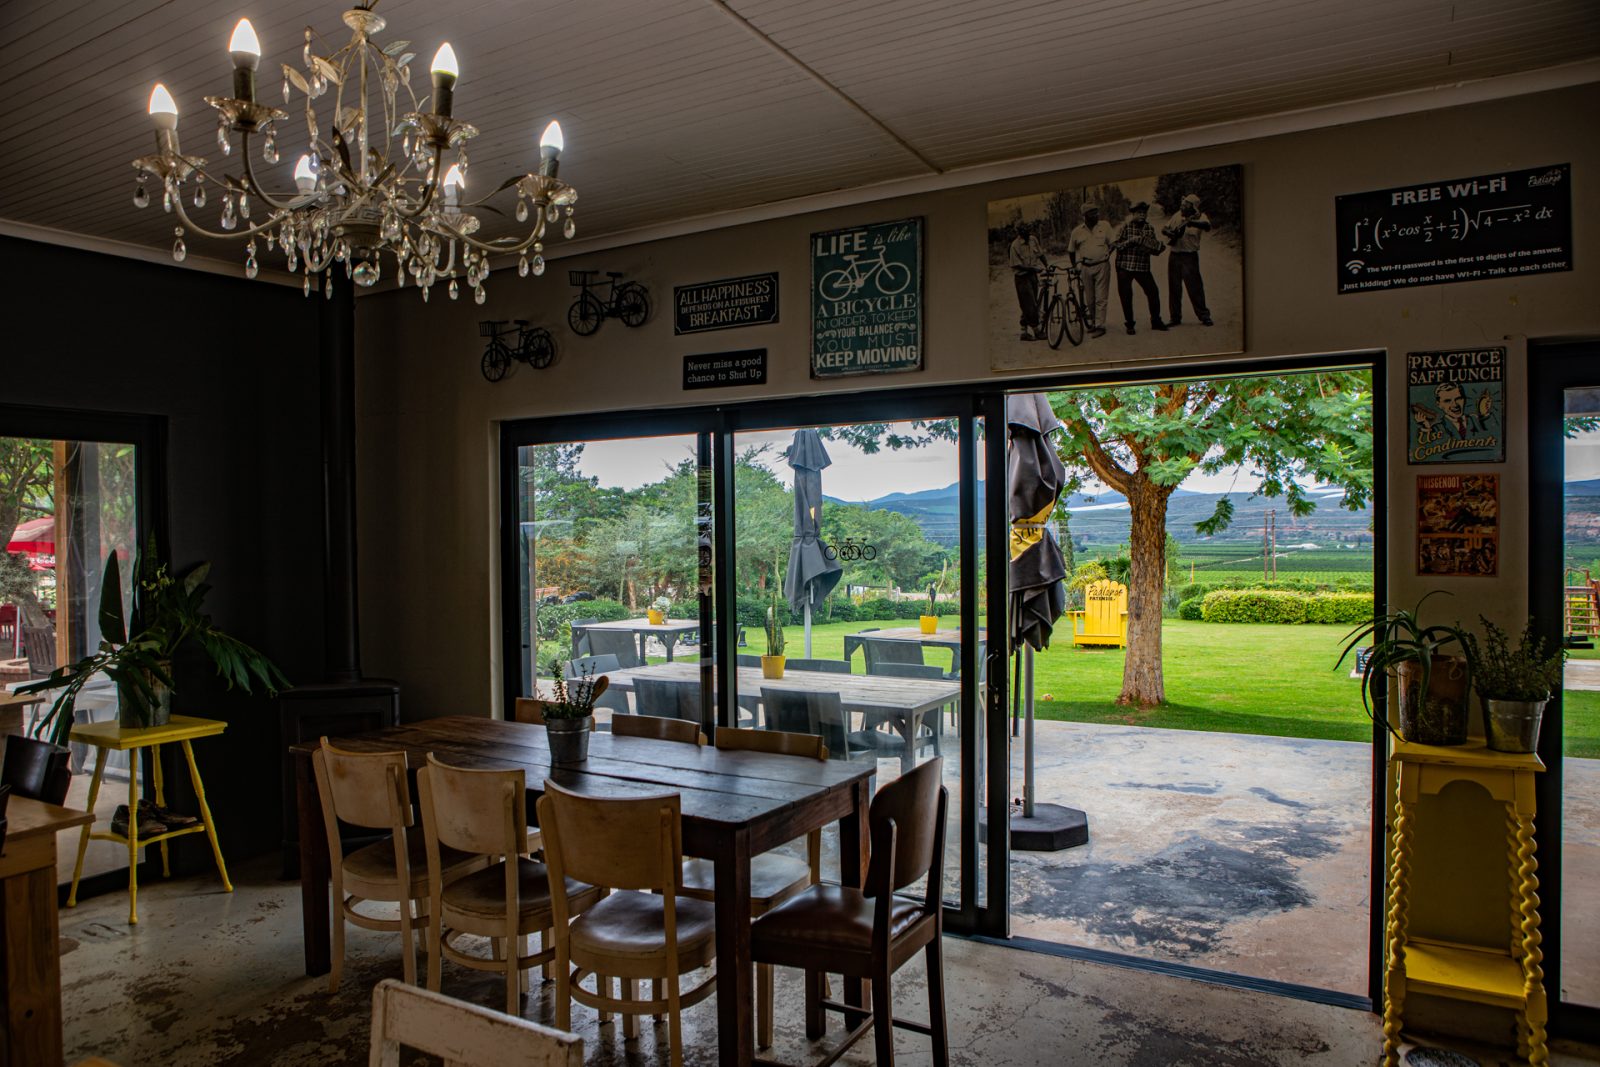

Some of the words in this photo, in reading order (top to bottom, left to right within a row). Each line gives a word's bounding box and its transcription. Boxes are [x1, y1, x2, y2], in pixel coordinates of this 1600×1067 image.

[1391, 187, 1441, 206] FREE
[1446, 176, 1508, 198] Wi-Fi
[816, 231, 868, 257] LIFE
[874, 234, 884, 245] is
[887, 225, 912, 243] like
[1402, 259, 1436, 270] password
[1485, 251, 1507, 261] digits
[1344, 283, 1359, 291] Just
[1360, 279, 1391, 288] kidding!
[1393, 277, 1406, 285] We
[1488, 267, 1507, 275] Talk
[1520, 263, 1540, 271] each
[680, 290, 700, 306] ALL
[702, 280, 770, 302] HAPPINESS
[681, 302, 712, 314] DEPENDS
[712, 300, 724, 310] ON
[731, 294, 771, 307] LEISURELY
[816, 303, 829, 318] A
[833, 293, 916, 317] BICYCLE
[816, 319, 826, 329] IN
[830, 314, 867, 328] ORDER
[872, 313, 886, 324] TO
[888, 309, 916, 322] KEEP
[836, 327, 856, 339] YOUR
[859, 323, 894, 337] BALANCE
[816, 338, 852, 353] YOU
[867, 332, 917, 348] MUST
[688, 361, 711, 371] Never
[713, 359, 732, 369] miss
[741, 355, 762, 368] good
[816, 351, 854, 369] KEEP
[857, 345, 917, 365] MOVING
[1411, 351, 1501, 369] PRACTICE
[688, 373, 715, 383] chance
[718, 372, 726, 380] to
[729, 370, 747, 380] Shut
[750, 369, 762, 379] Up
[1410, 370, 1445, 384] SAFE
[1449, 366, 1501, 382] LUNCH
[1414, 435, 1496, 461] Condiments
[1418, 431, 1443, 445] Use
